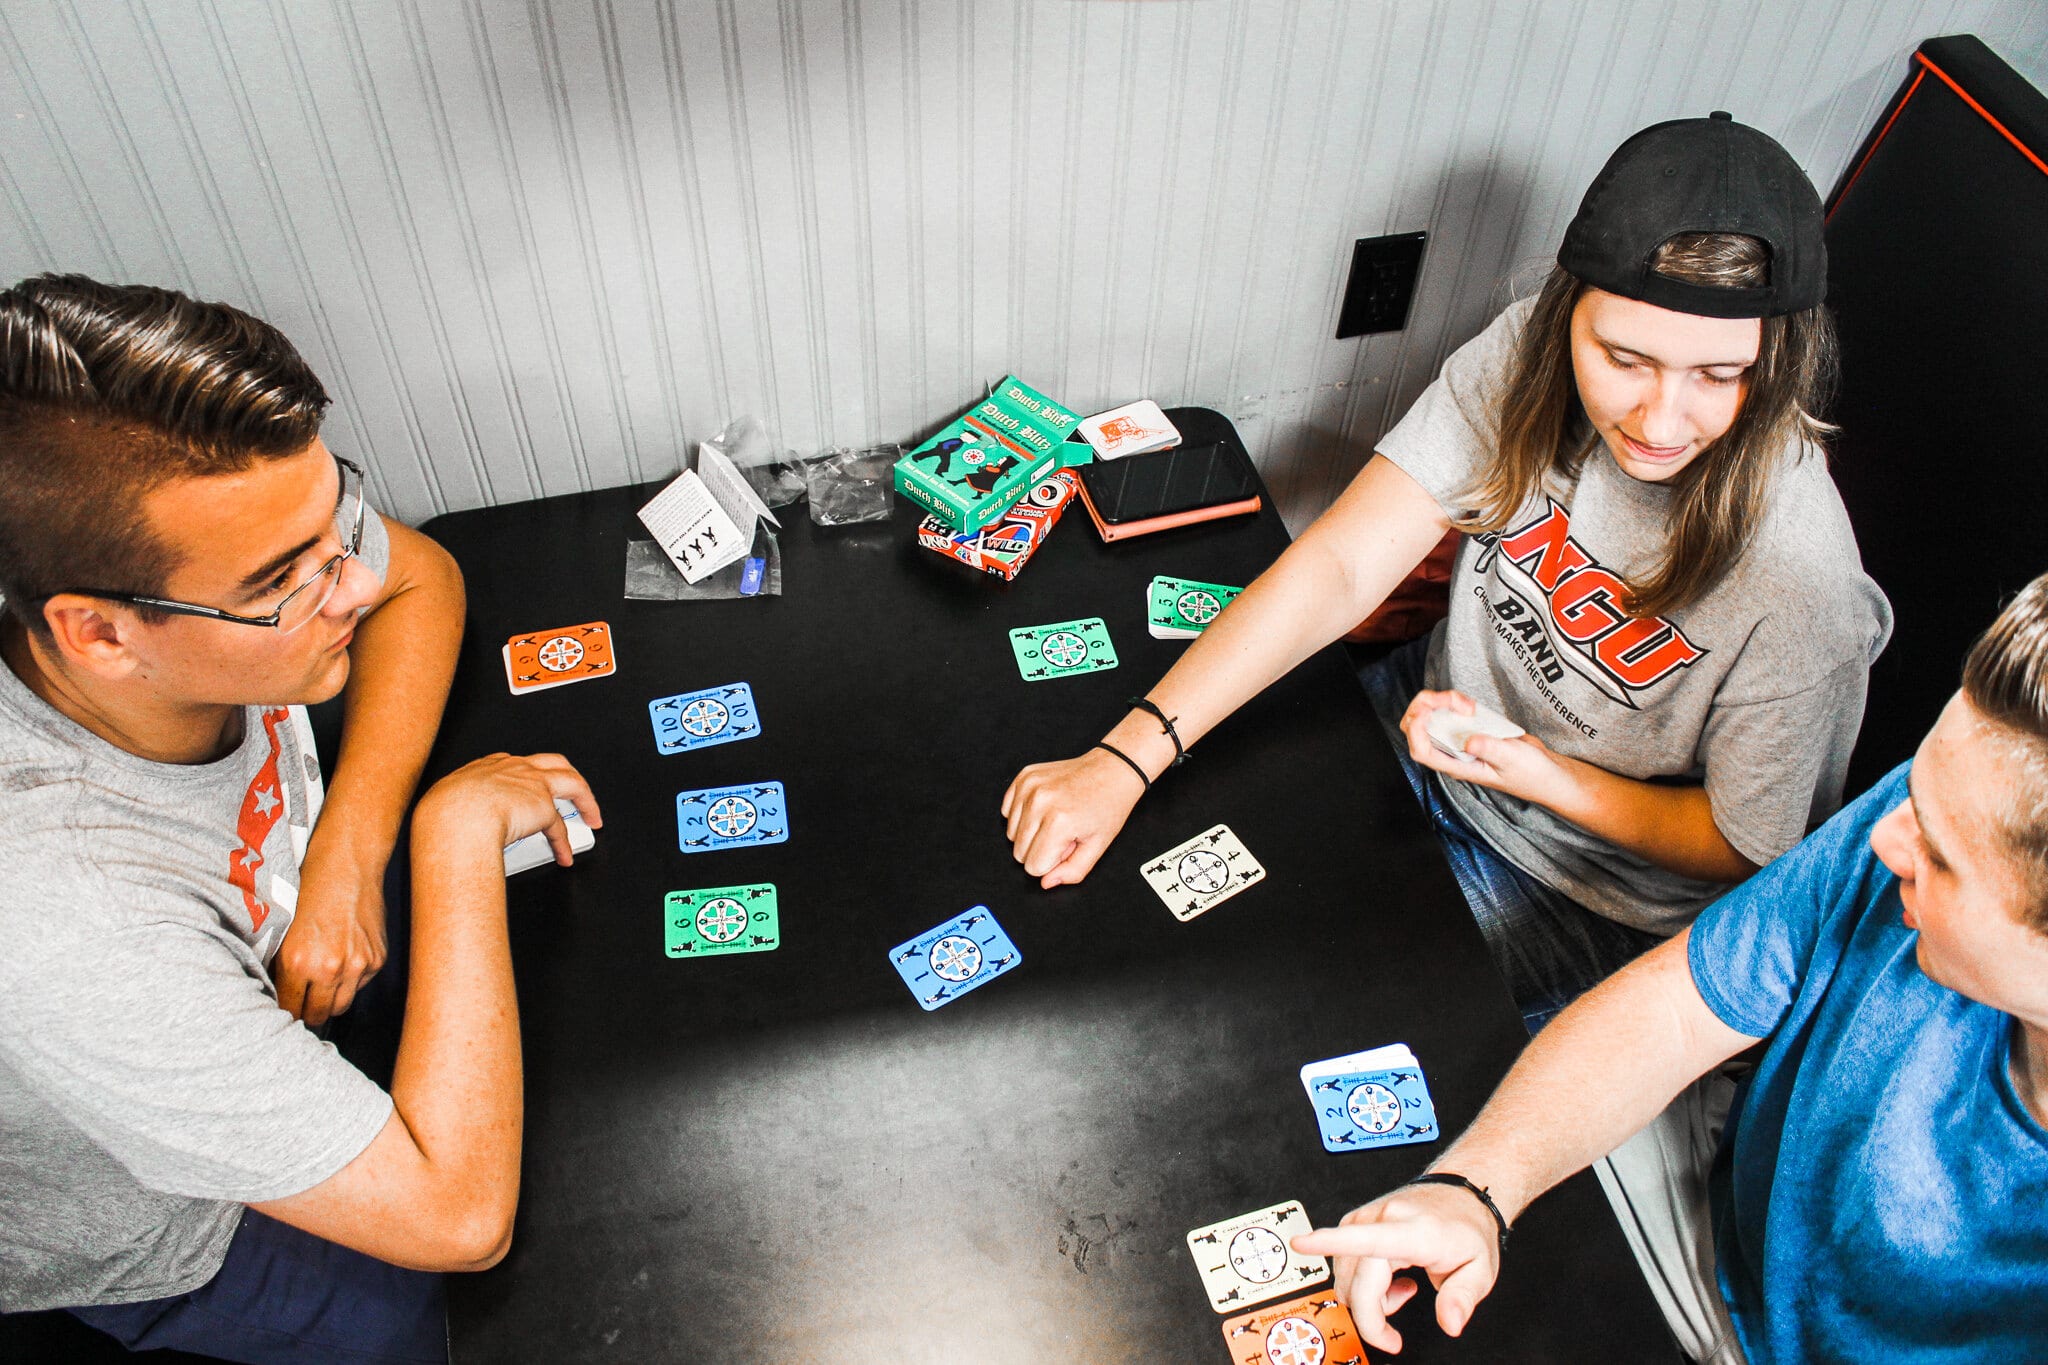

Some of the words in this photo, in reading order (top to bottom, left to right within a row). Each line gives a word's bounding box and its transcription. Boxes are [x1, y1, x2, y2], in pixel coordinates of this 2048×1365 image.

[1007, 386, 1041, 412] Dutch
[1037, 405, 1067, 429] Blitz
[981, 402, 1019, 430] Dutch
[1016, 425, 1051, 450] Blitz
[904, 478, 931, 504] Dutch
[932, 496, 956, 521] Blitz
[978, 497, 1003, 520] Dutch
[1005, 482, 1025, 500] Blitz
[918, 534, 952, 550] UNO
[986, 537, 1027, 551] WILD
[1499, 494, 1711, 691] NGU
[1159, 598, 1174, 607] 5
[1493, 595, 1564, 684] BAND
[1473, 586, 1498, 623] CHRIST
[1494, 623, 1527, 660] MAKES
[1523, 656, 1540, 682] THE
[1536, 679, 1598, 739] DIFFERENCE
[732, 702, 748, 718] 10
[661, 717, 678, 733] 10
[761, 807, 778, 817] 2
[686, 816, 703, 826] 2
[1166, 882, 1180, 894] 4
[1404, 1096, 1422, 1109] 2
[1325, 1106, 1343, 1119] 2
[1330, 1329, 1346, 1342] 4
